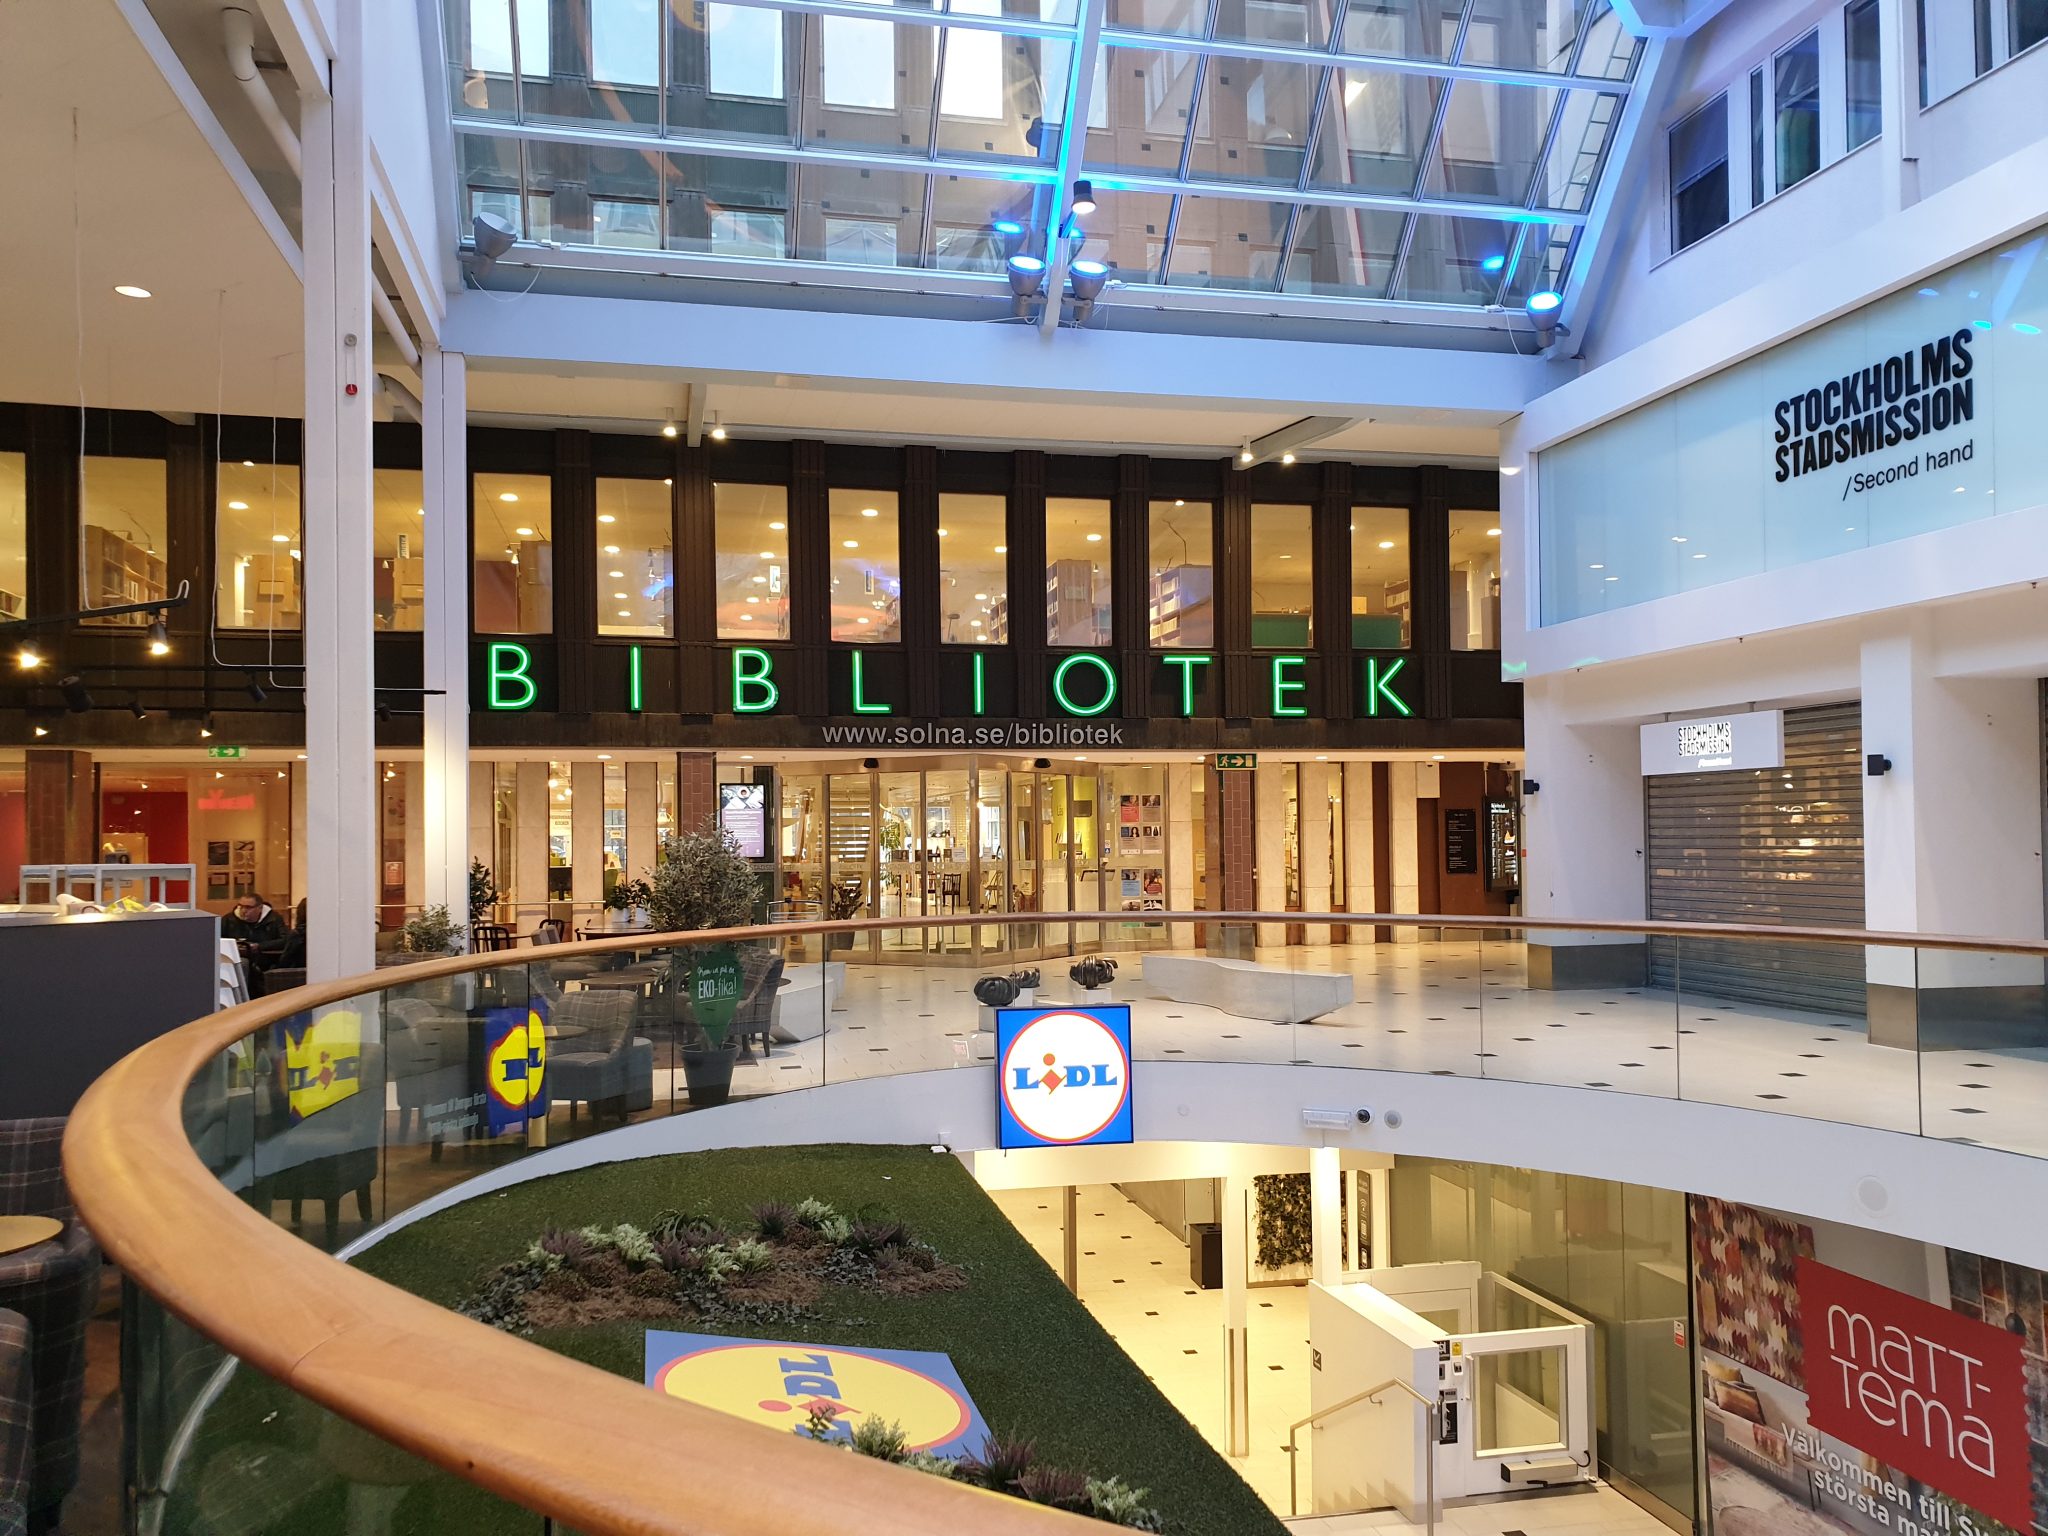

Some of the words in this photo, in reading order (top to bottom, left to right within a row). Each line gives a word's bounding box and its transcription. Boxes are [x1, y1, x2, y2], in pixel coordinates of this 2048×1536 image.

[1774, 328, 1973, 443] STOCKHOLMS
[1775, 378, 1974, 483] STADSMISSION
[1926, 439, 1973, 472] hand
[488, 642, 1413, 717] BIBLIOTEK
[822, 722, 1123, 747] www.solna.se/bibliotek
[1678, 722, 1731, 742] STOCKHOLMS
[1678, 738, 1731, 756] STADSMISSION
[698, 976, 736, 999] EKO-fika!
[1781, 1422, 1912, 1511] Välkommen
[1918, 1494, 1950, 1531] till
[1814, 1468, 1890, 1526] största
